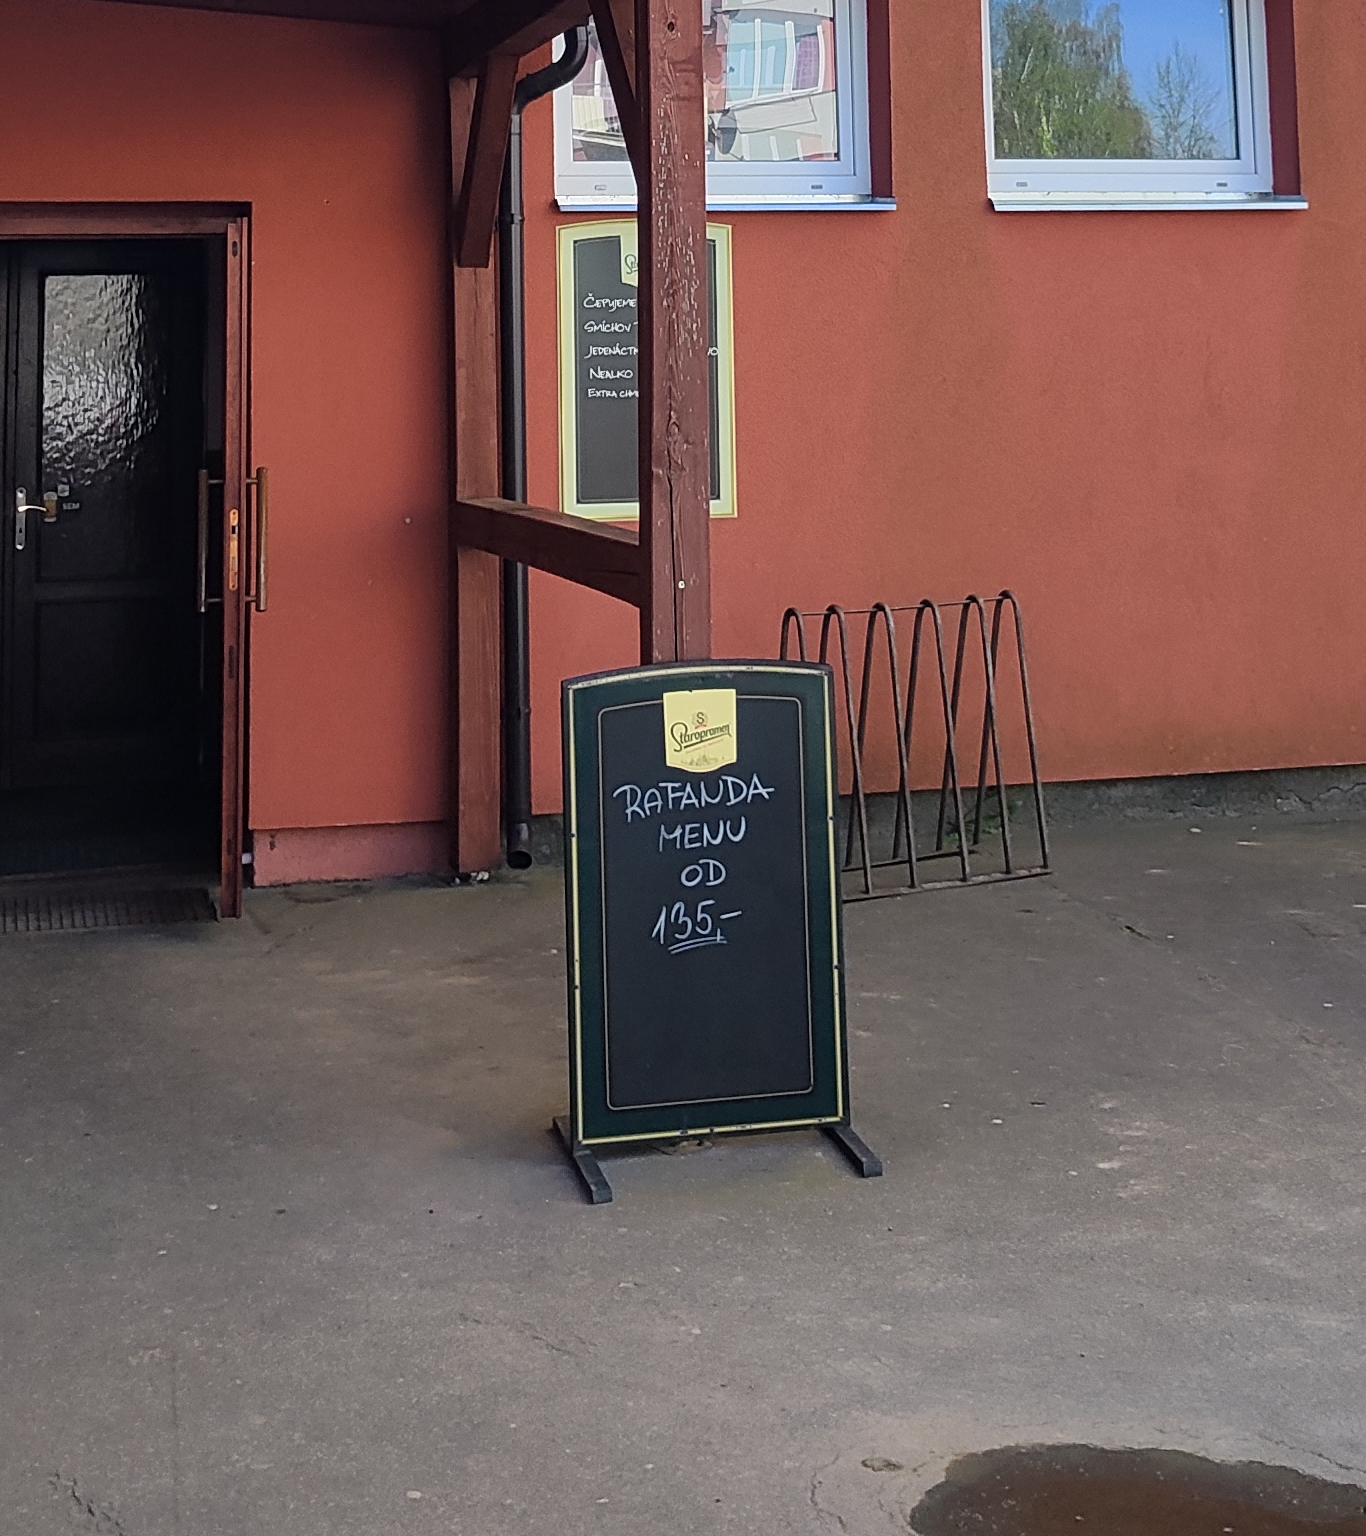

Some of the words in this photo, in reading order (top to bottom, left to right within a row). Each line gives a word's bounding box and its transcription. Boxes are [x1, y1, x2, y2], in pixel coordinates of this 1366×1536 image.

[583, 293, 638, 312] ČEPUJEME
[584, 320, 632, 333] SMÍCHOV
[589, 366, 633, 379] NEALKO
[587, 388, 617, 398] EXTRA
[670, 722, 732, 752] Staropramen
[612, 773, 775, 822] RAFANDA
[659, 816, 747, 852] MENU
[680, 859, 727, 887] OD
